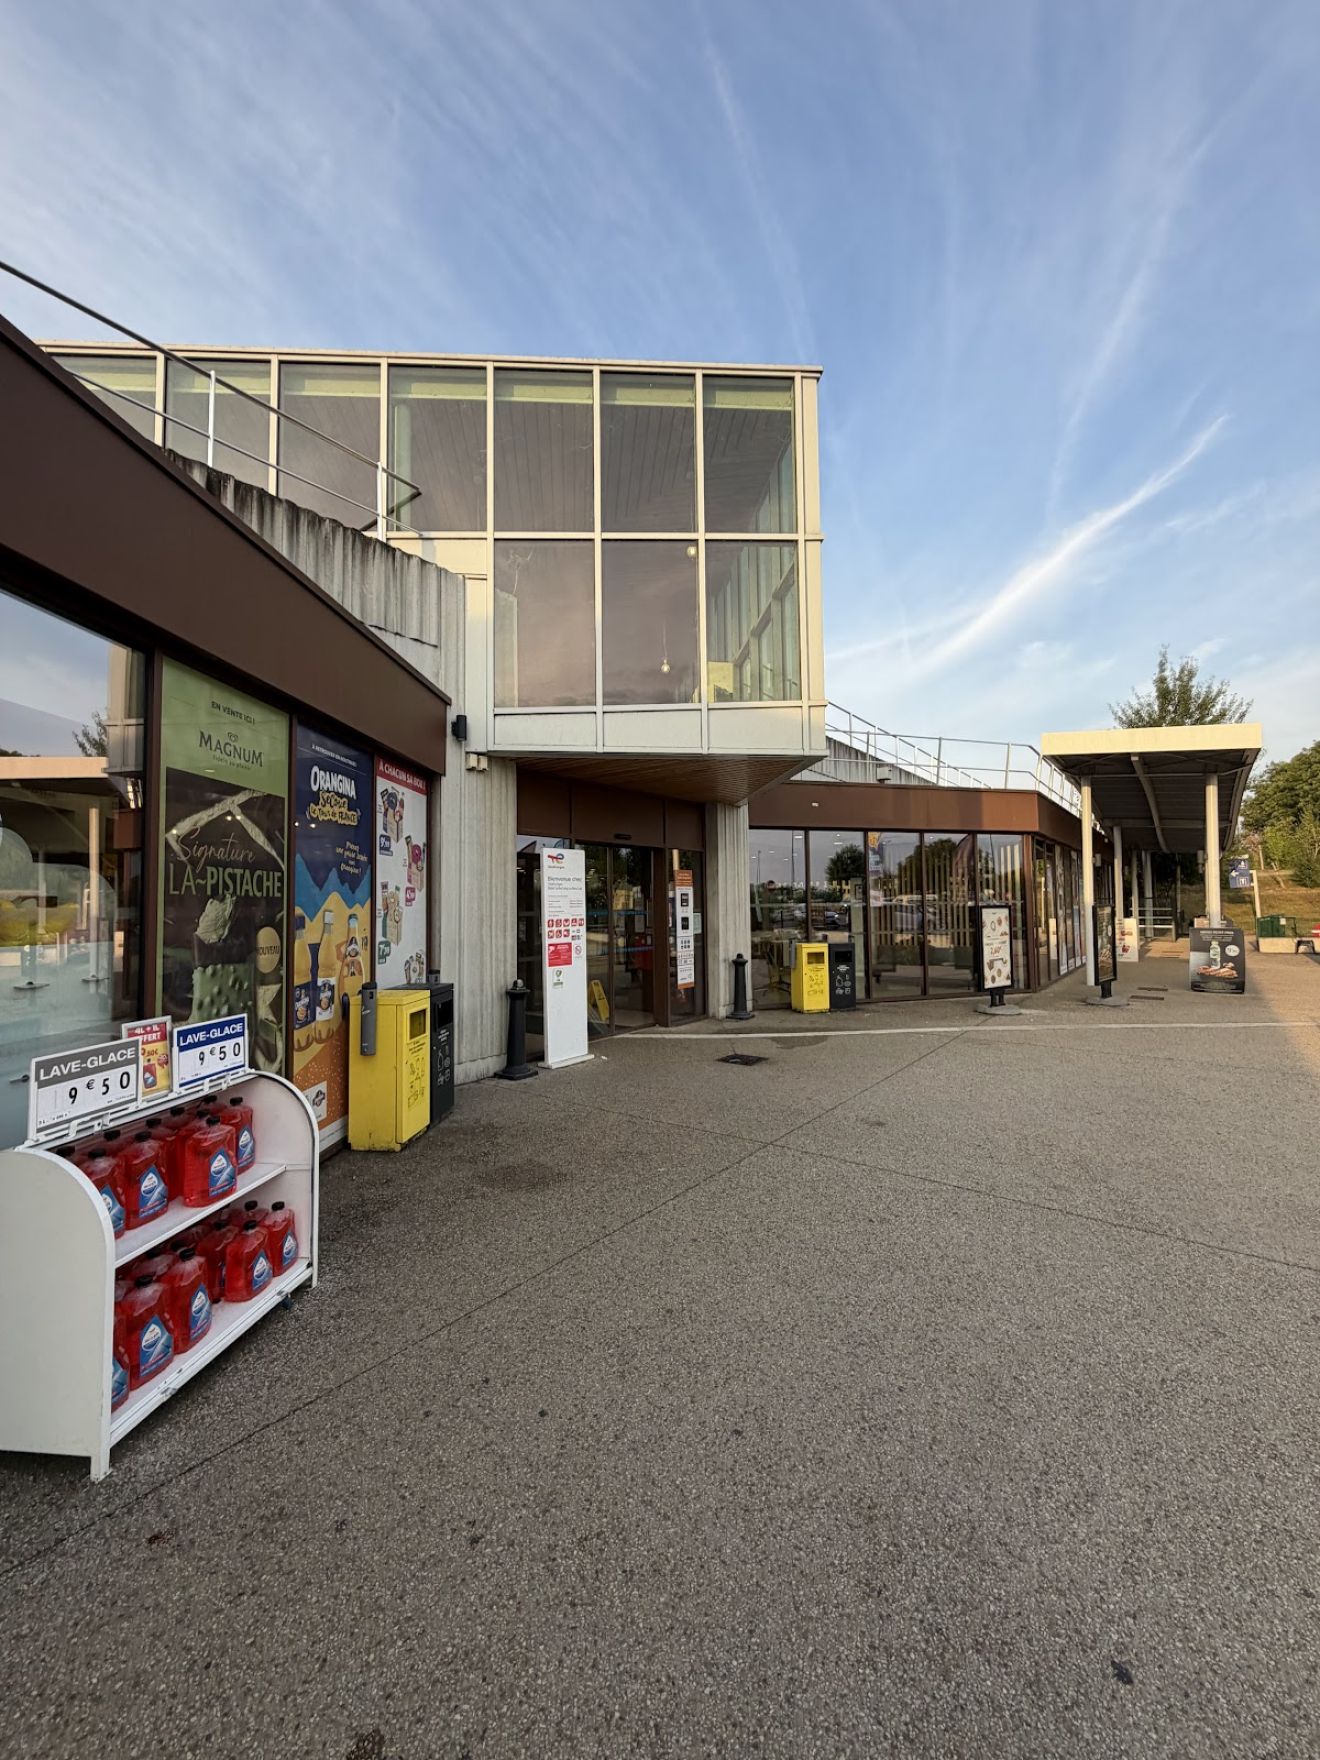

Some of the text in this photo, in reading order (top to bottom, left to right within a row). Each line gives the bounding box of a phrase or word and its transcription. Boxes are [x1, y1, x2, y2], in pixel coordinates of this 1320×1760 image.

[211, 701, 221, 711] EN
[222, 704, 243, 720] VENTE
[199, 730, 263, 768] MAGNUM
[310, 765, 357, 800] ORANGINA
[177, 825, 255, 873] Signature
[206, 865, 283, 897] PISTACHE
[141, 1032, 161, 1042] FFERT
[179, 1022, 243, 1046] LAVE-GLACE
[40, 1047, 136, 1081] LAVE-GLACE
